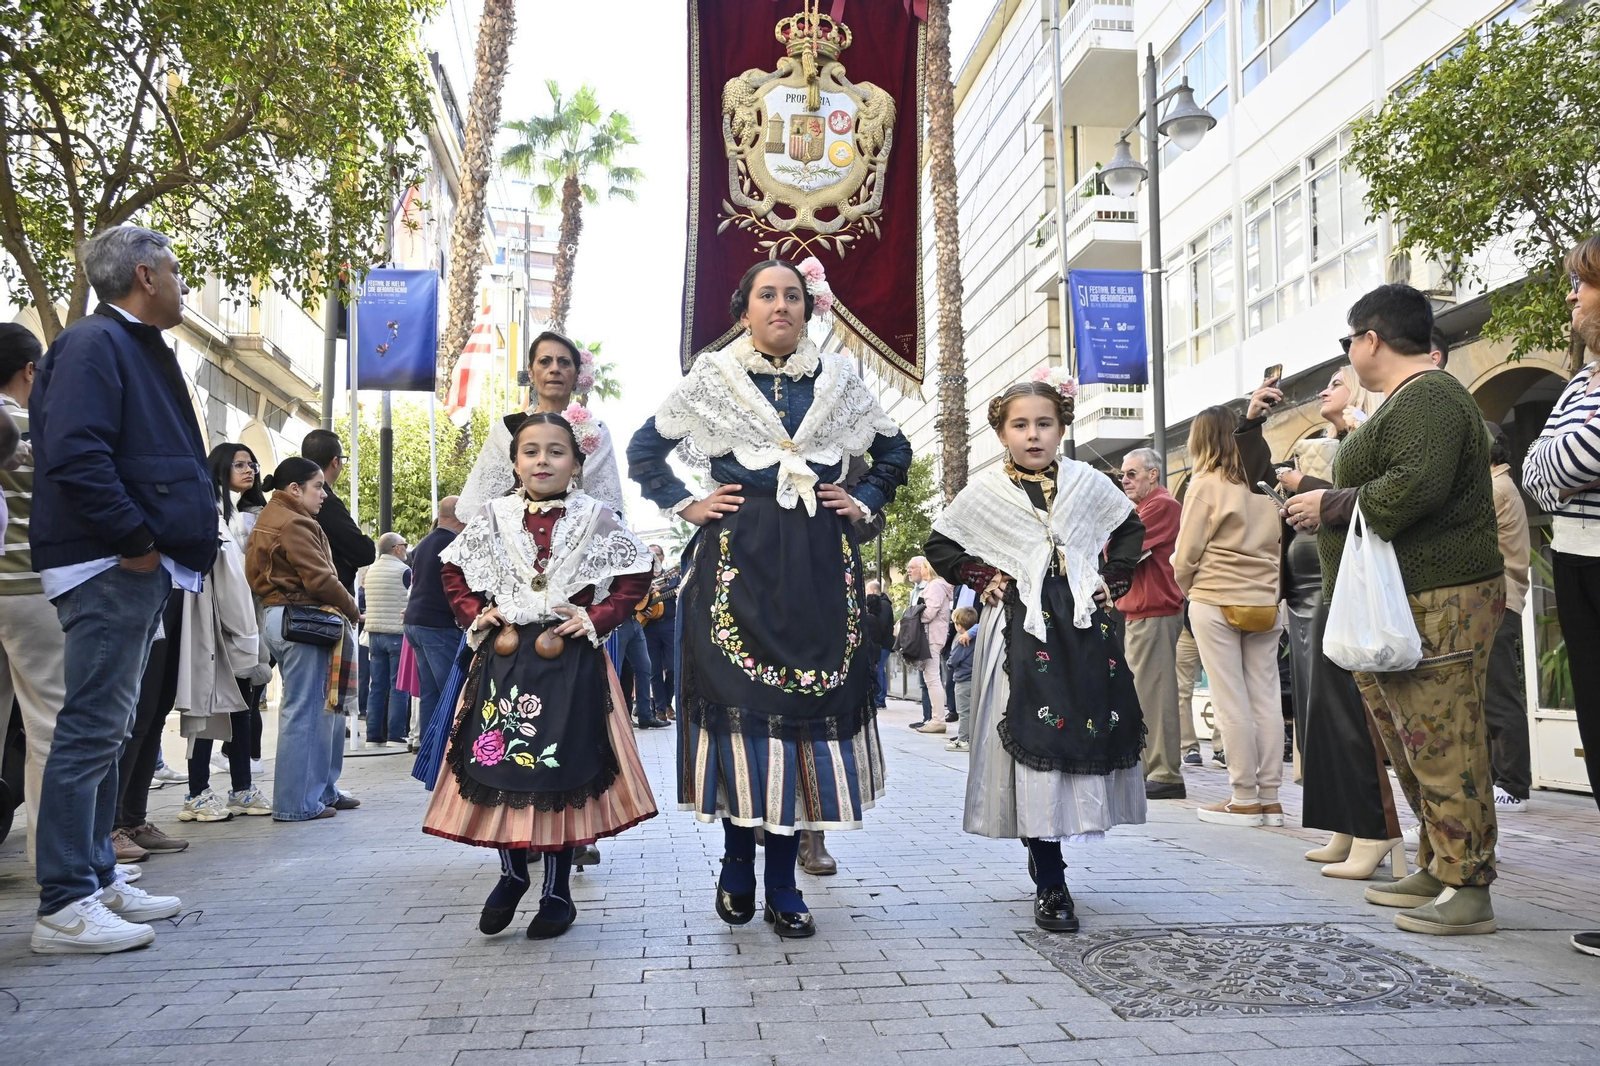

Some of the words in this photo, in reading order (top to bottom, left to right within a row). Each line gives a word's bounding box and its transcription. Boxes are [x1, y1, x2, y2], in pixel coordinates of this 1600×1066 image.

[357, 279, 366, 297] 51
[1089, 285, 1109, 294] FESTIVAL
[1110, 286, 1116, 294] DE
[1117, 286, 1134, 294] HUELVA
[1078, 285, 1089, 307] 51
[1090, 294, 1099, 302] CINE
[1100, 294, 1137, 303] IBEROAMERICANO
